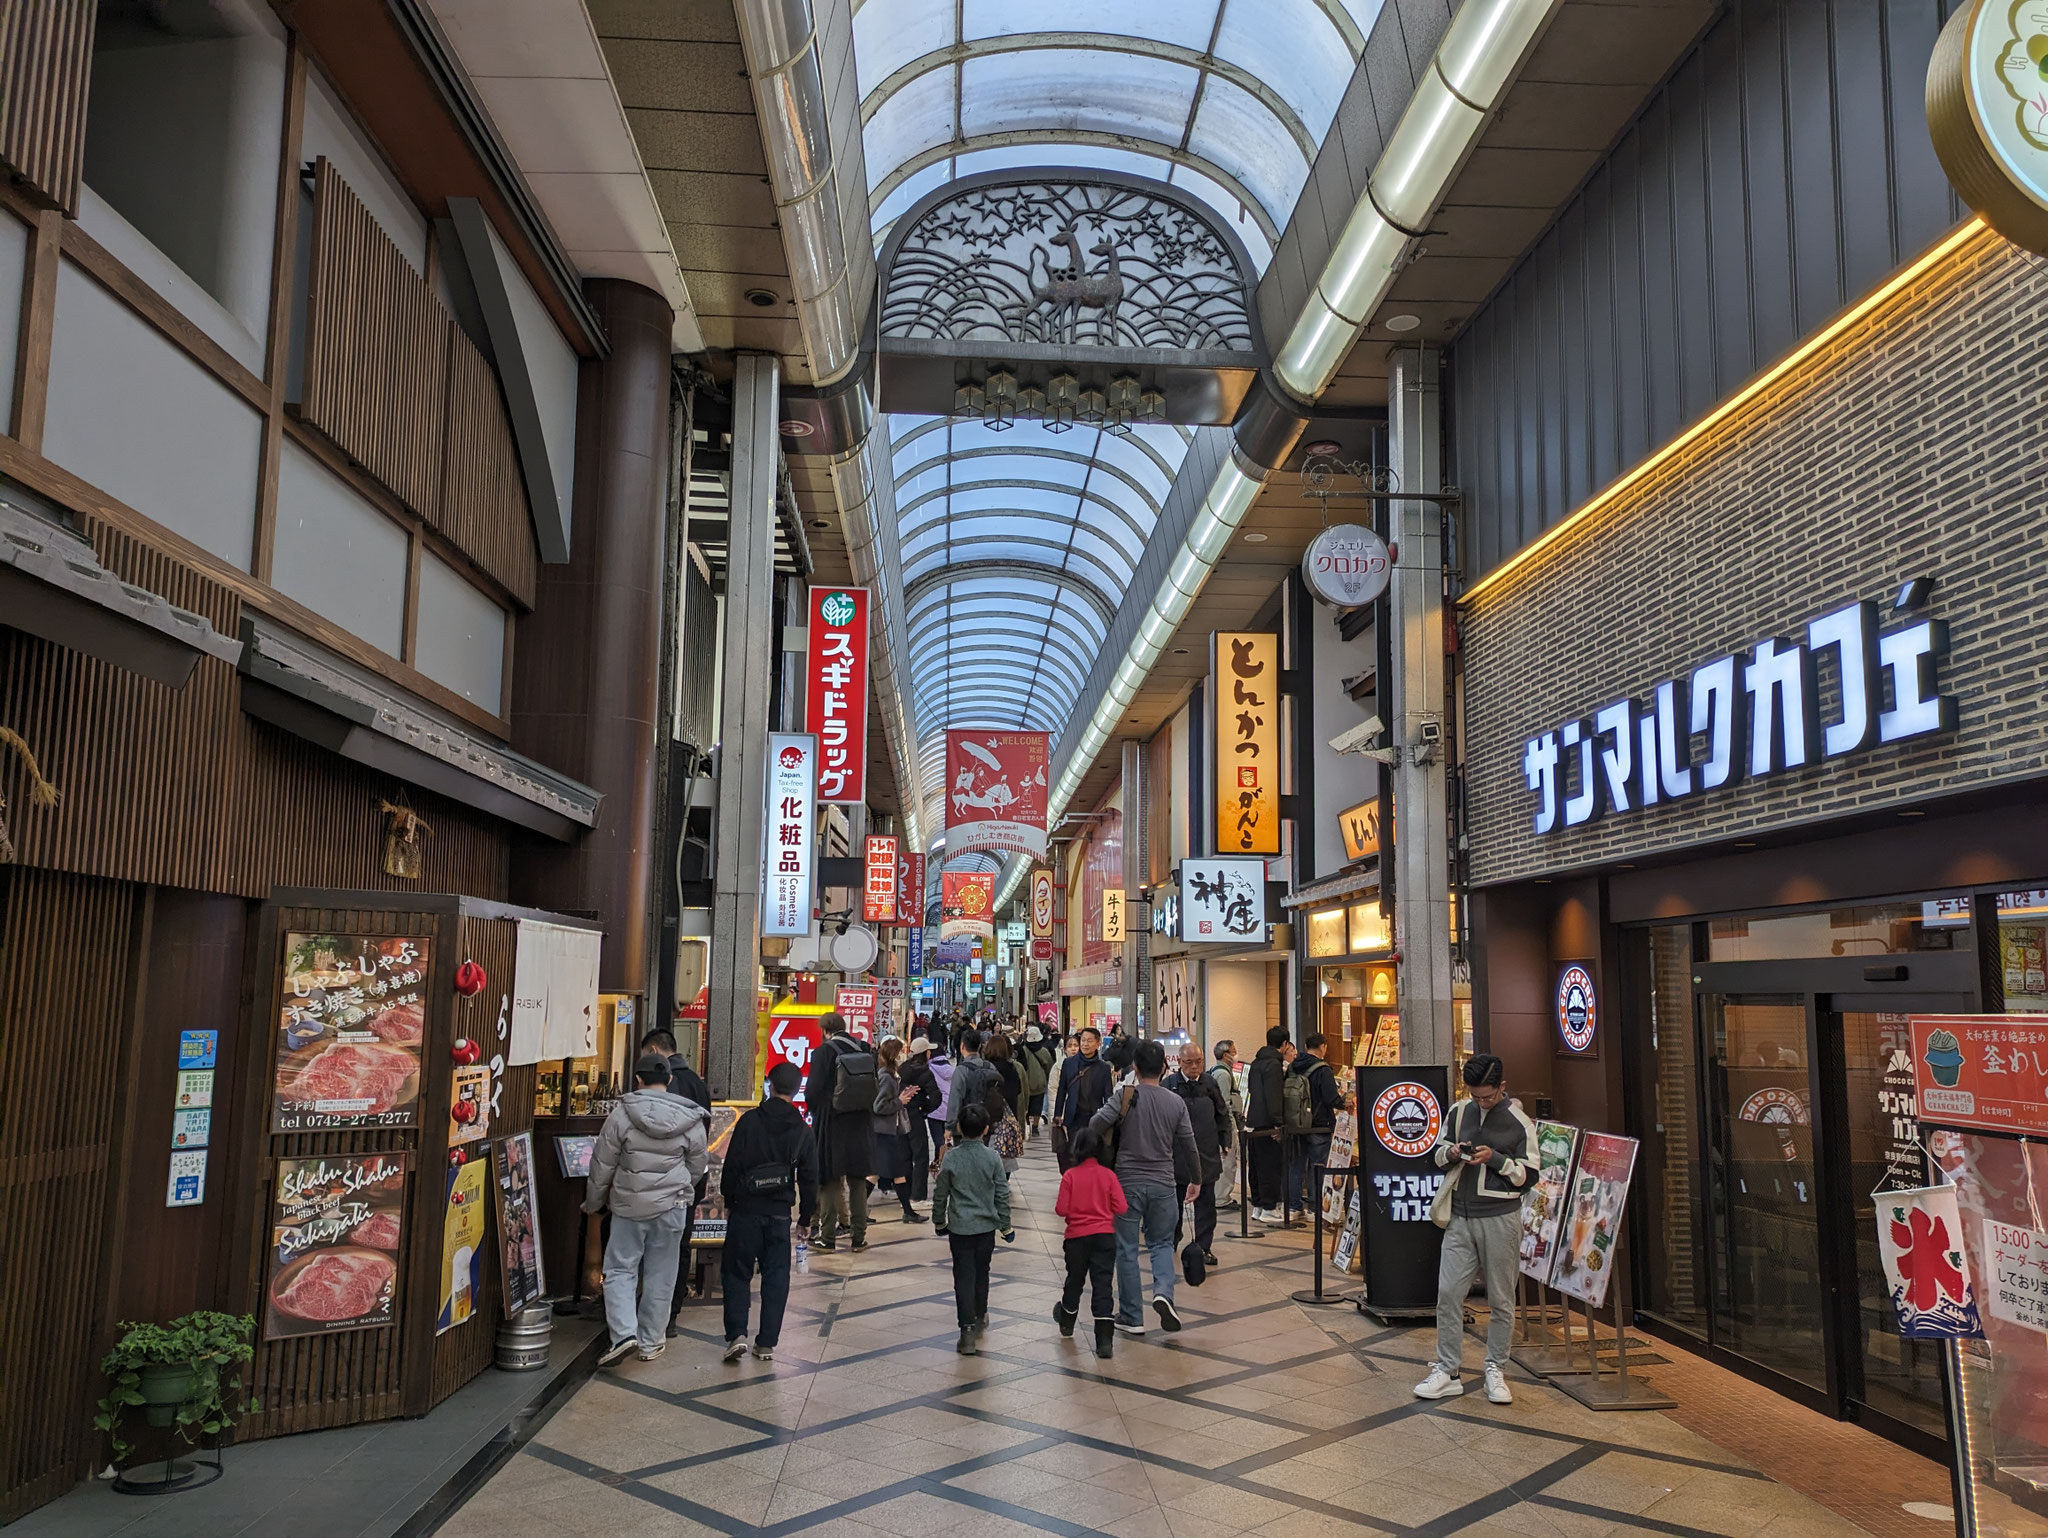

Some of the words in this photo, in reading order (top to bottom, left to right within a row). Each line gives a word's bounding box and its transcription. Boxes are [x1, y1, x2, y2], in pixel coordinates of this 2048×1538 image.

[1330, 541, 1373, 551] ジュエリー
[1316, 556, 1387, 574] クロカワ
[1344, 582, 1361, 593] 2F
[1231, 637, 1265, 759] とんかつ
[1524, 577, 1943, 835] サンマルクカフェ
[819, 633, 855, 797] スギドラッグ
[1001, 736, 1043, 746] WELCOME
[781, 786, 798, 794] Shop
[1237, 787, 1263, 850] がんこ
[779, 796, 803, 872] 化粧品
[870, 840, 894, 851] トレカ
[967, 832, 1025, 843] ひがしむき商店街
[788, 878, 799, 928] Cosmetics
[1038, 886, 1049, 924] ダイソー
[1107, 893, 1121, 938] 牛カツ
[911, 926, 920, 971] 田中ホテイヤ
[292, 941, 419, 998] しゃぶしゃぶ
[843, 995, 870, 1005] 本日!
[335, 1006, 377, 1028] 黒毛和牛
[379, 1000, 396, 1013] A5
[1983, 1045, 2048, 1076] 釜めし
[1884, 1076, 1906, 1085] CHOCO
[281, 1101, 315, 1112] ご予約
[1376, 1085, 1418, 1118] CHOCO
[1419, 1091, 1438, 1118] CRO
[1960, 1103, 1970, 1112] 2F
[280, 1116, 300, 1128] tel
[306, 1112, 411, 1127] 0742-27-7277
[1382, 1131, 1436, 1153] サンマルクカフェ
[283, 1161, 342, 1199] Shabu
[342, 1158, 400, 1195] Shabu
[282, 1195, 322, 1217] Japanese
[297, 1206, 321, 1221] black
[322, 1196, 340, 1211] beef
[280, 1202, 373, 1255] Sukiyaki
[1993, 1225, 2030, 1250] 15:00
[1890, 1206, 1965, 1312] 氷
[1999, 1289, 2048, 1314] 何卒ご了承
[326, 1320, 356, 1328] DINNING
[360, 1316, 391, 1324] RATSUKU
